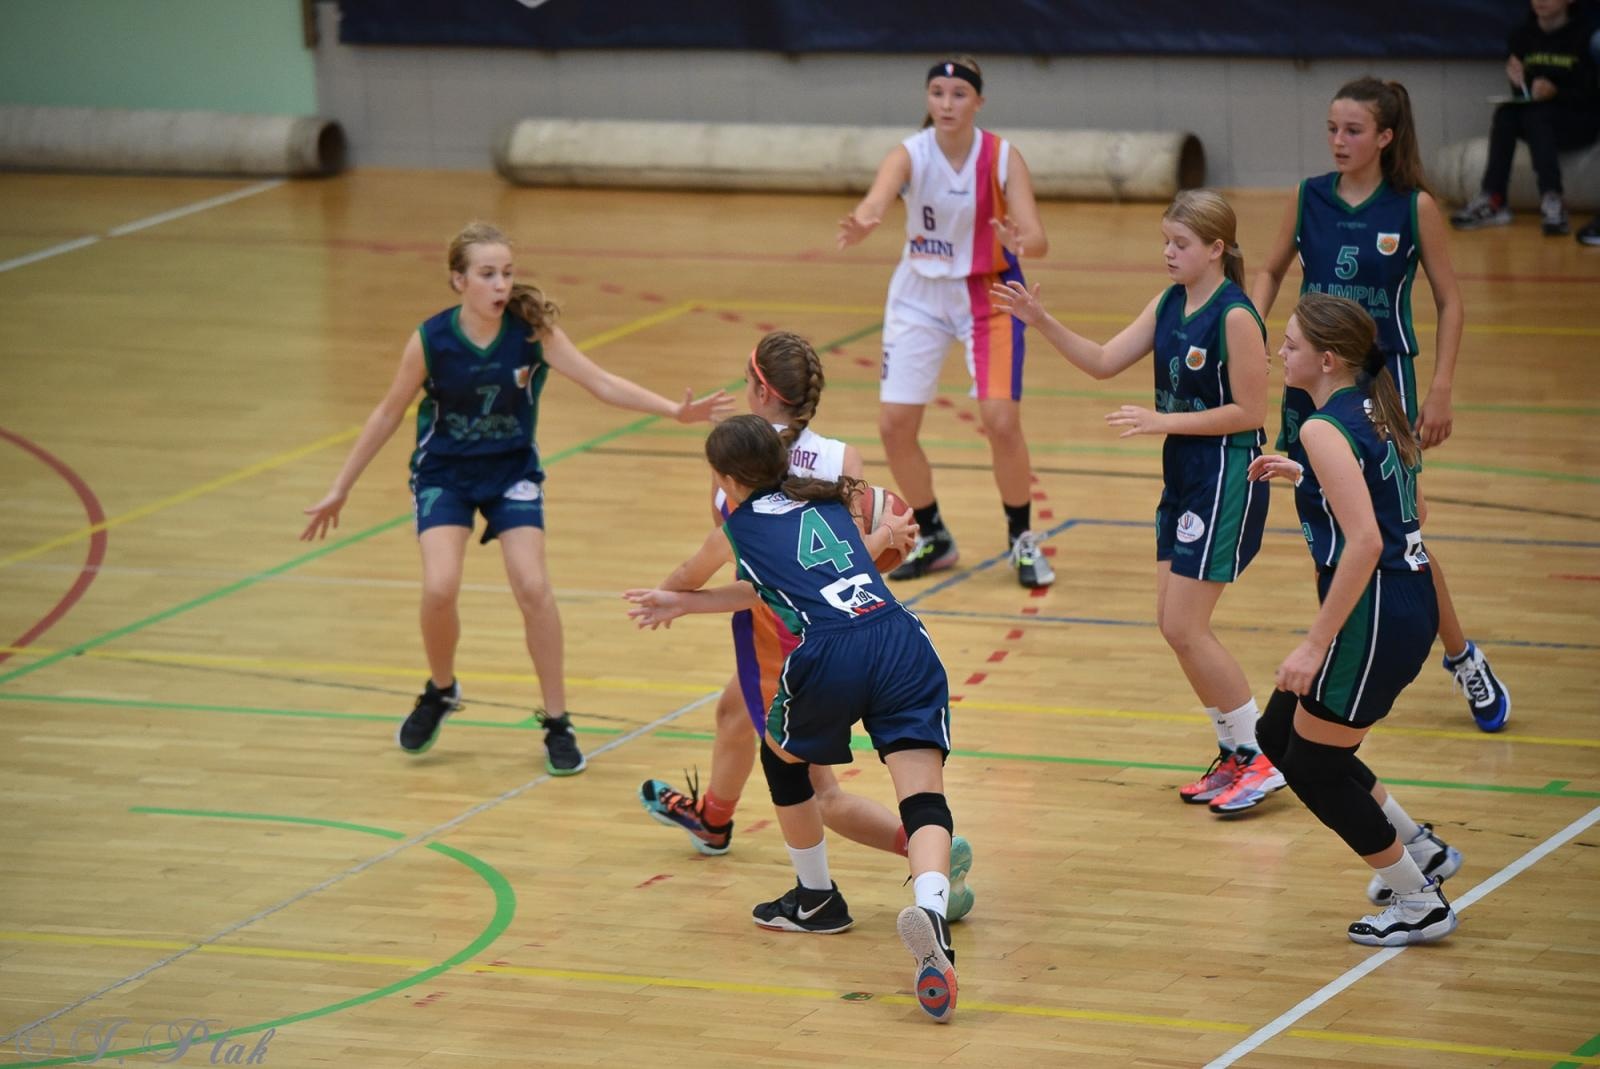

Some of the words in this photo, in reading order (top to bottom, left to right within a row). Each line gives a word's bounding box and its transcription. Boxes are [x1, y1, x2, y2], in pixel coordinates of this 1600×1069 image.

[923, 206, 936, 231] 6
[1334, 246, 1359, 280] 5
[477, 385, 501, 415] 7
[419, 487, 443, 517] 7
[797, 507, 854, 574] 4
